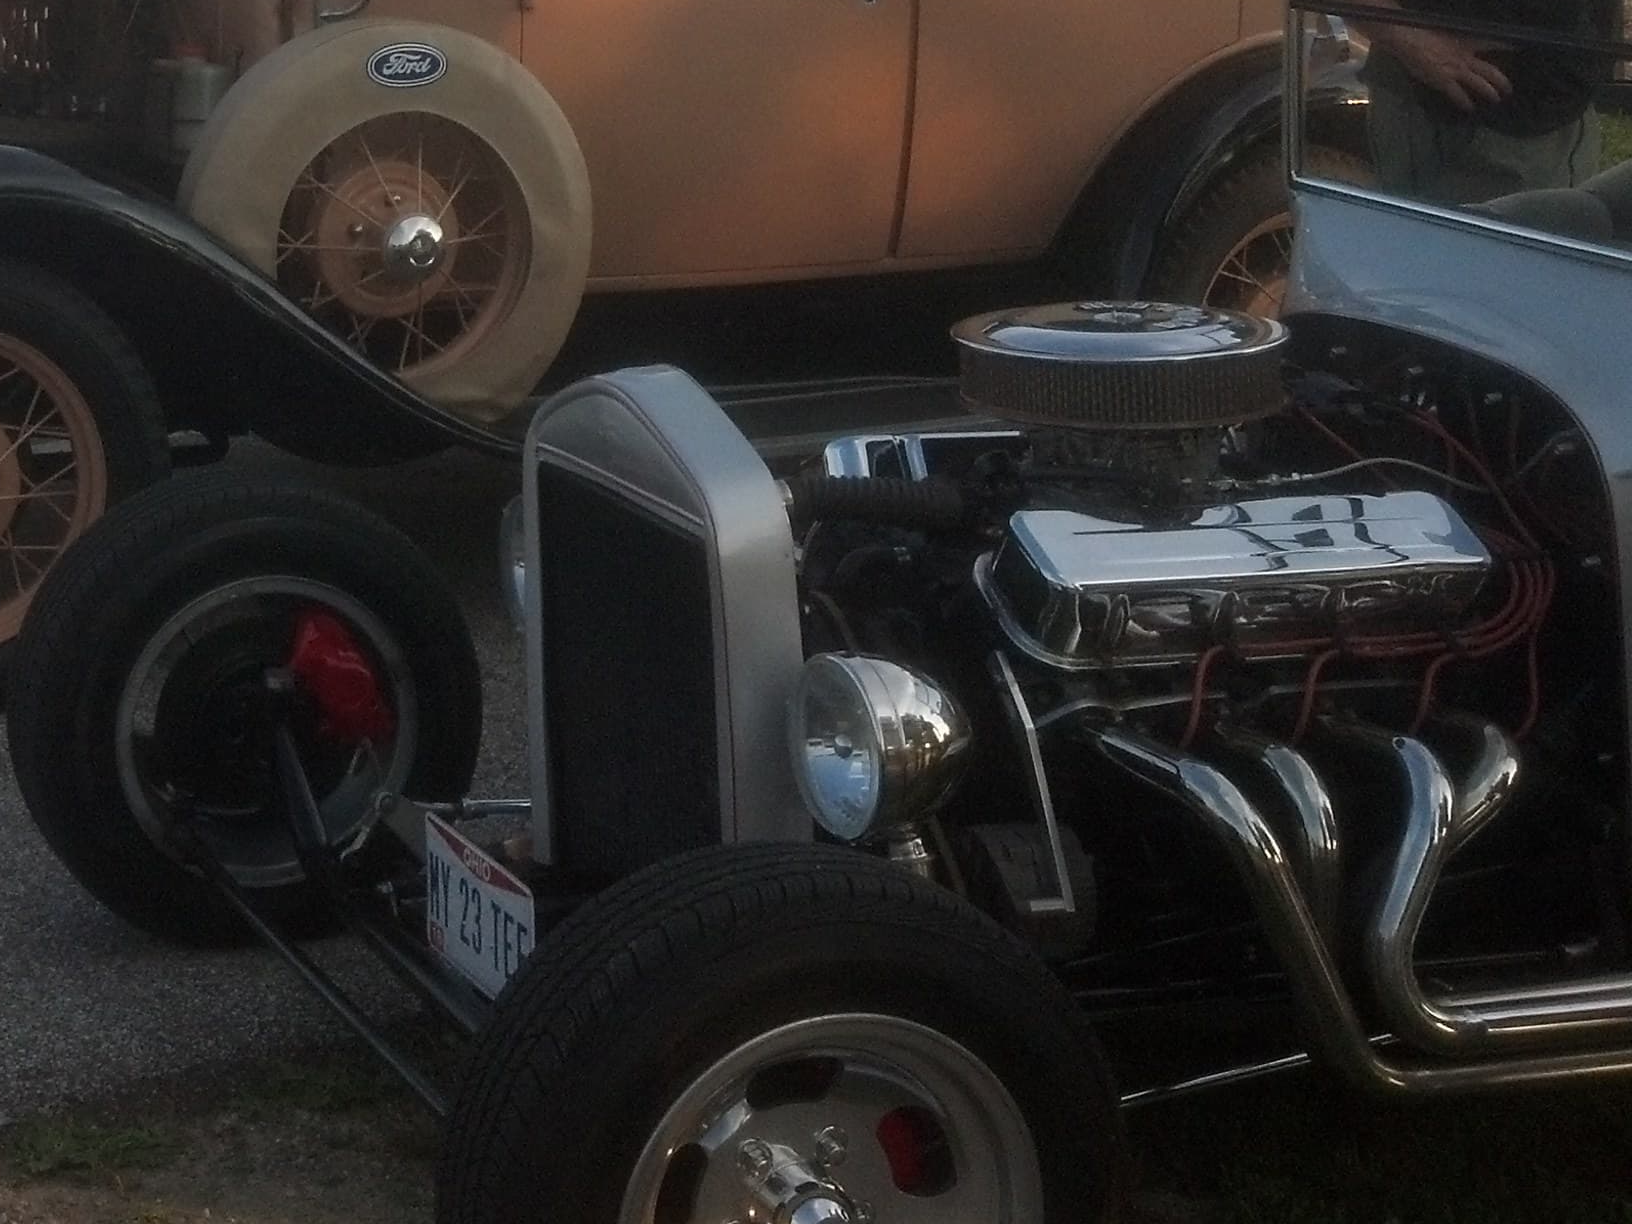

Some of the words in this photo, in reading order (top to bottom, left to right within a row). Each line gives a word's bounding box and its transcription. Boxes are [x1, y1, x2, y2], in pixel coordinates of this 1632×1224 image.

[383, 53, 432, 75] Ford
[463, 846, 492, 882] OHIO
[429, 851, 451, 928] MY
[459, 877, 483, 955] 23
